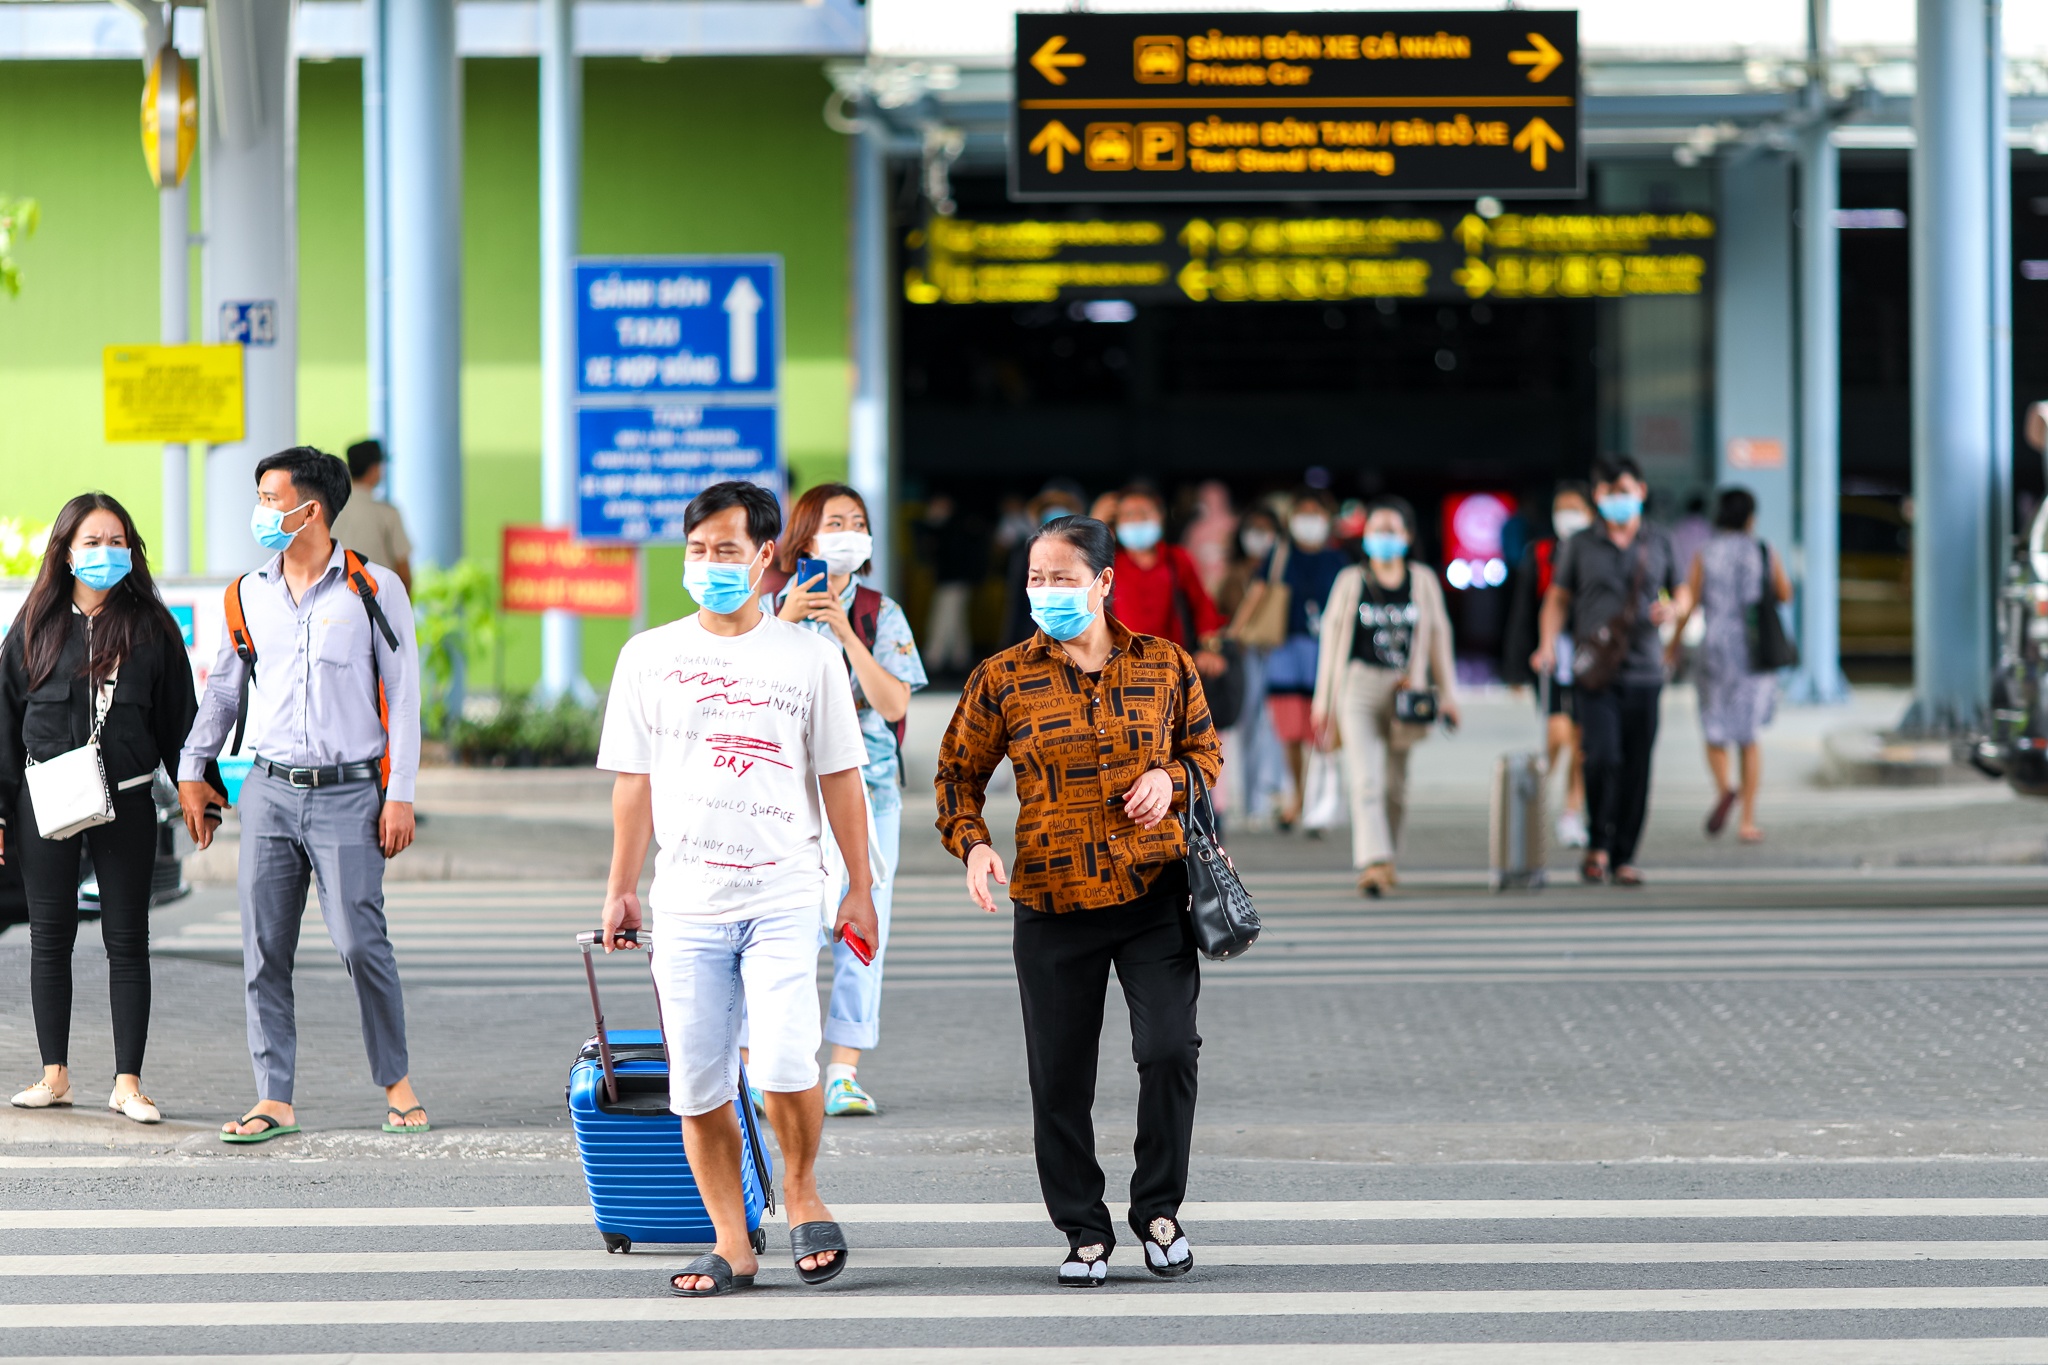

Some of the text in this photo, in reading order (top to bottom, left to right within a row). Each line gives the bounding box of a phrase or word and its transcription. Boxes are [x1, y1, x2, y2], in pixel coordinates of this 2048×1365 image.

[1323, 34, 1361, 59] XE
[1361, 31, 1399, 59] CÁ
[1400, 31, 1471, 59] NHÂN
[1187, 61, 1313, 86] Private Car
[1320, 121, 1377, 146] TAXI
[1474, 121, 1509, 146] XE
[1187, 148, 1395, 176] Taxi Stand Parking
[702, 707, 756, 722] HABITAT
[1022, 697, 1065, 712] FASHION
[714, 755, 753, 777] DRY
[706, 797, 746, 813] WOULD
[750, 802, 796, 823] SUFFICE
[726, 844, 755, 860] DAY
